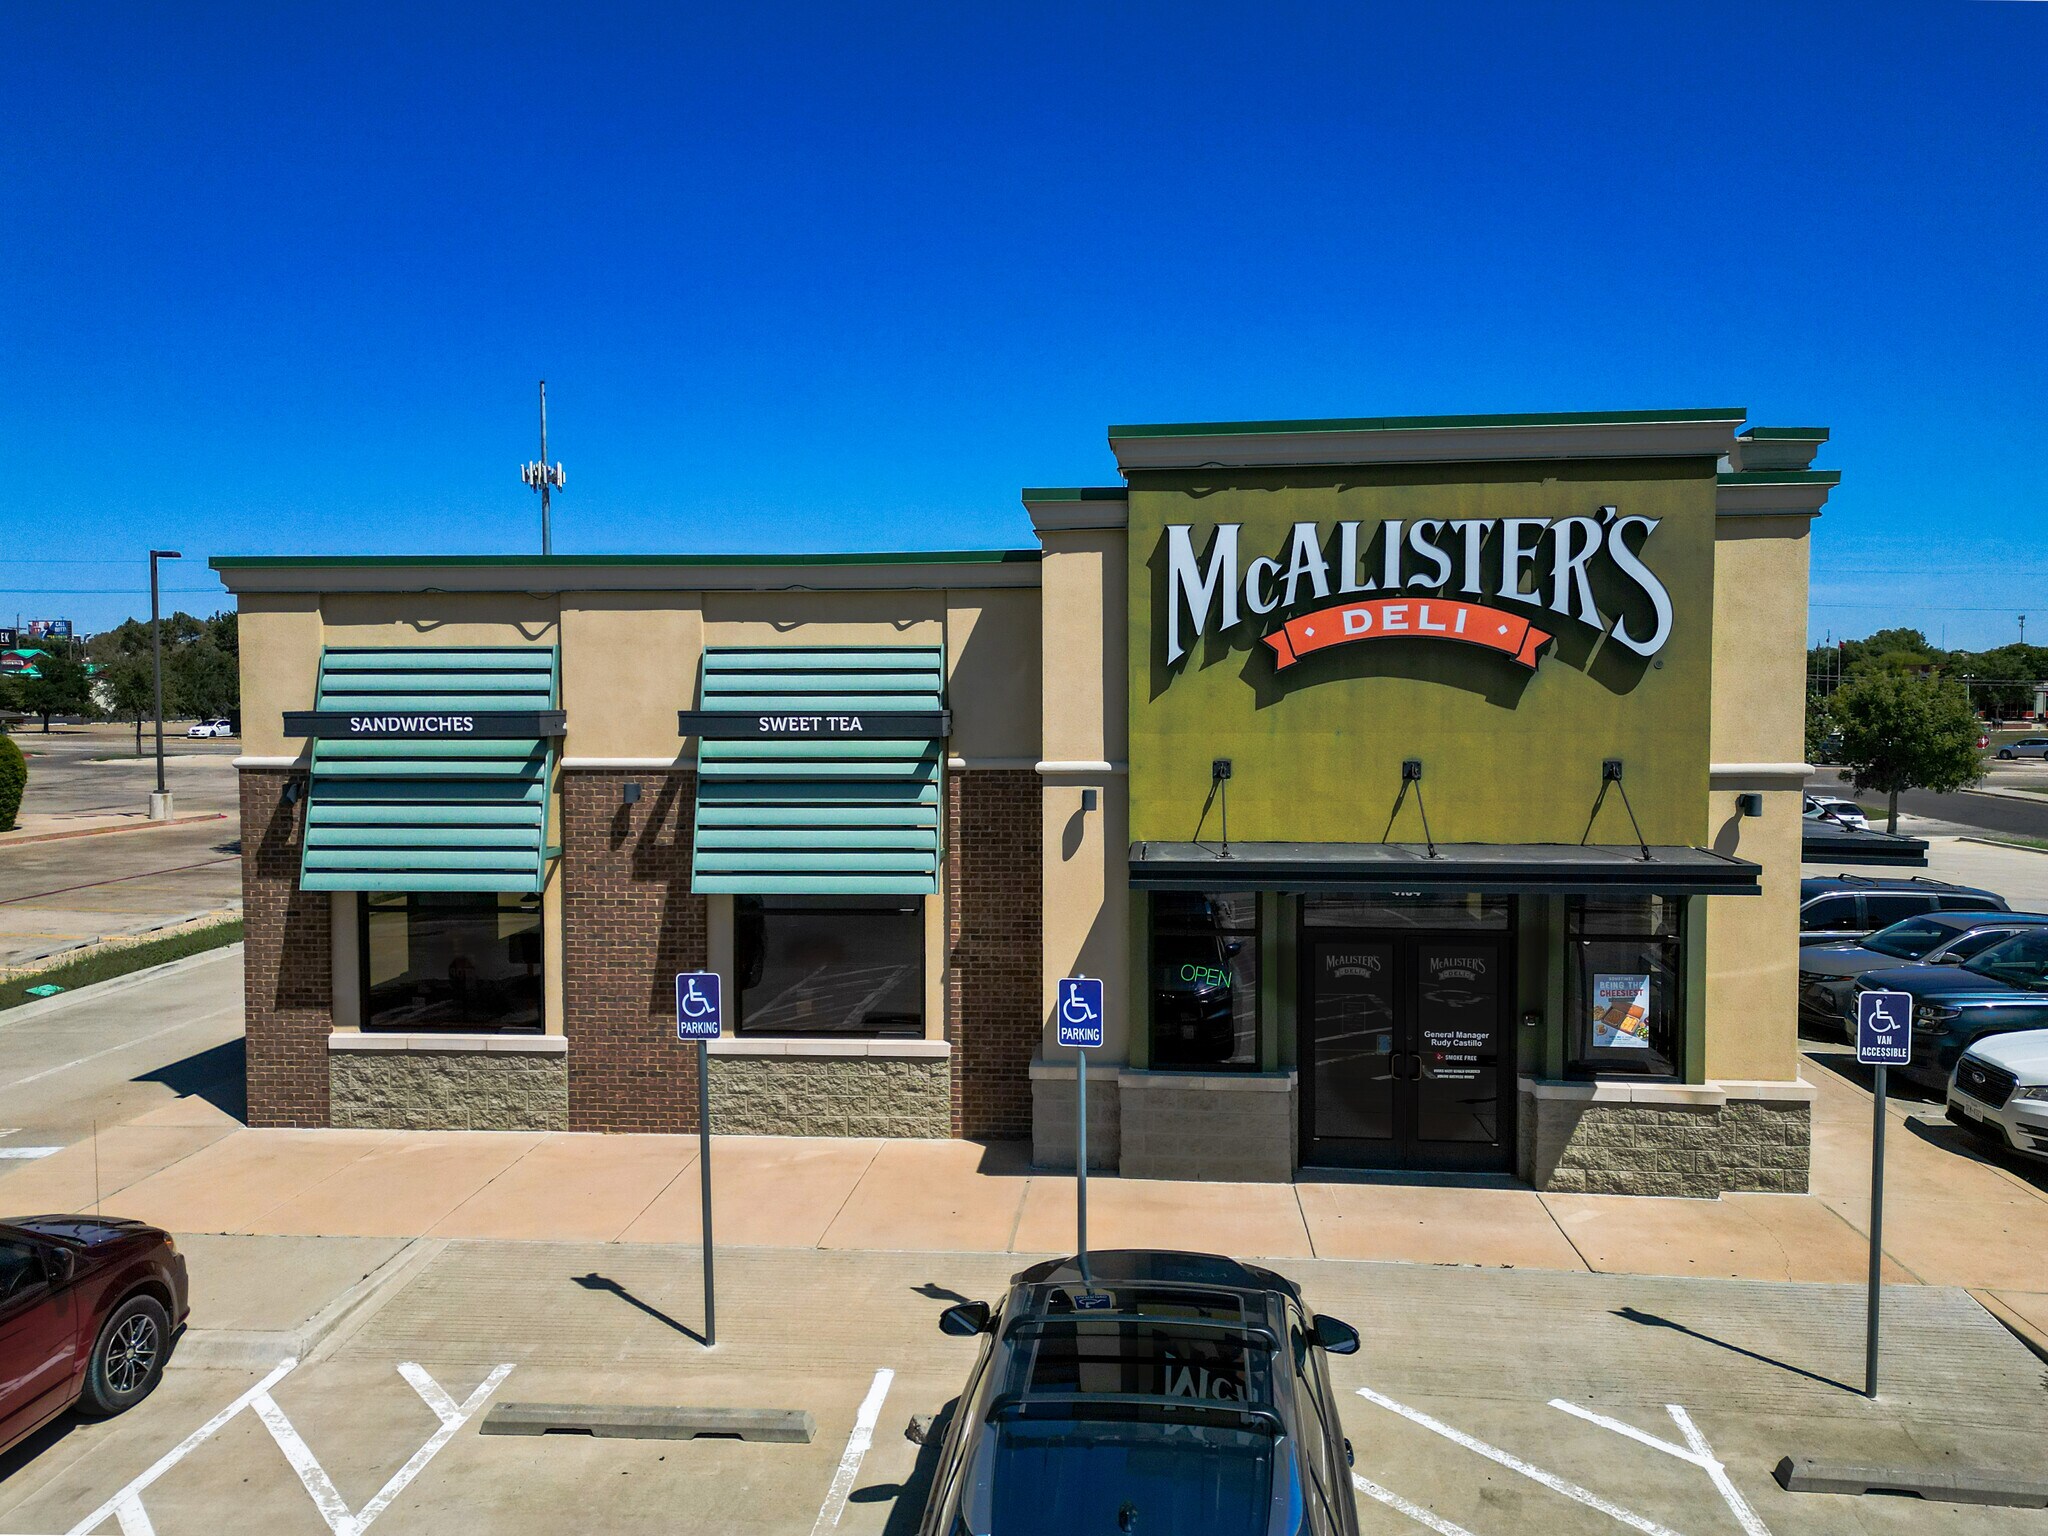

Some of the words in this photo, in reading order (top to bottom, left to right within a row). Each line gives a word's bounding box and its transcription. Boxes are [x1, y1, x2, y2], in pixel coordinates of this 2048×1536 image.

[1342, 605, 1468, 635] DELI
[350, 716, 474, 732] SANDWICHES
[759, 716, 822, 732] SWEET
[826, 716, 863, 732] TEA
[1181, 964, 1232, 988] OPEN
[1600, 981, 1625, 989] BEING
[1627, 981, 1644, 989] THE
[1600, 989, 1644, 997] CHEESIEST
[681, 1021, 718, 1034] PARKING
[1061, 1027, 1100, 1041] PARKING
[1424, 1030, 1454, 1038] General
[1456, 1031, 1490, 1040] Manager
[1876, 1035, 1893, 1045] VAN
[1431, 1039, 1452, 1047] Rudy
[1453, 1039, 1483, 1047] Castillo
[1861, 1047, 1907, 1058] ACCESSIBLE
